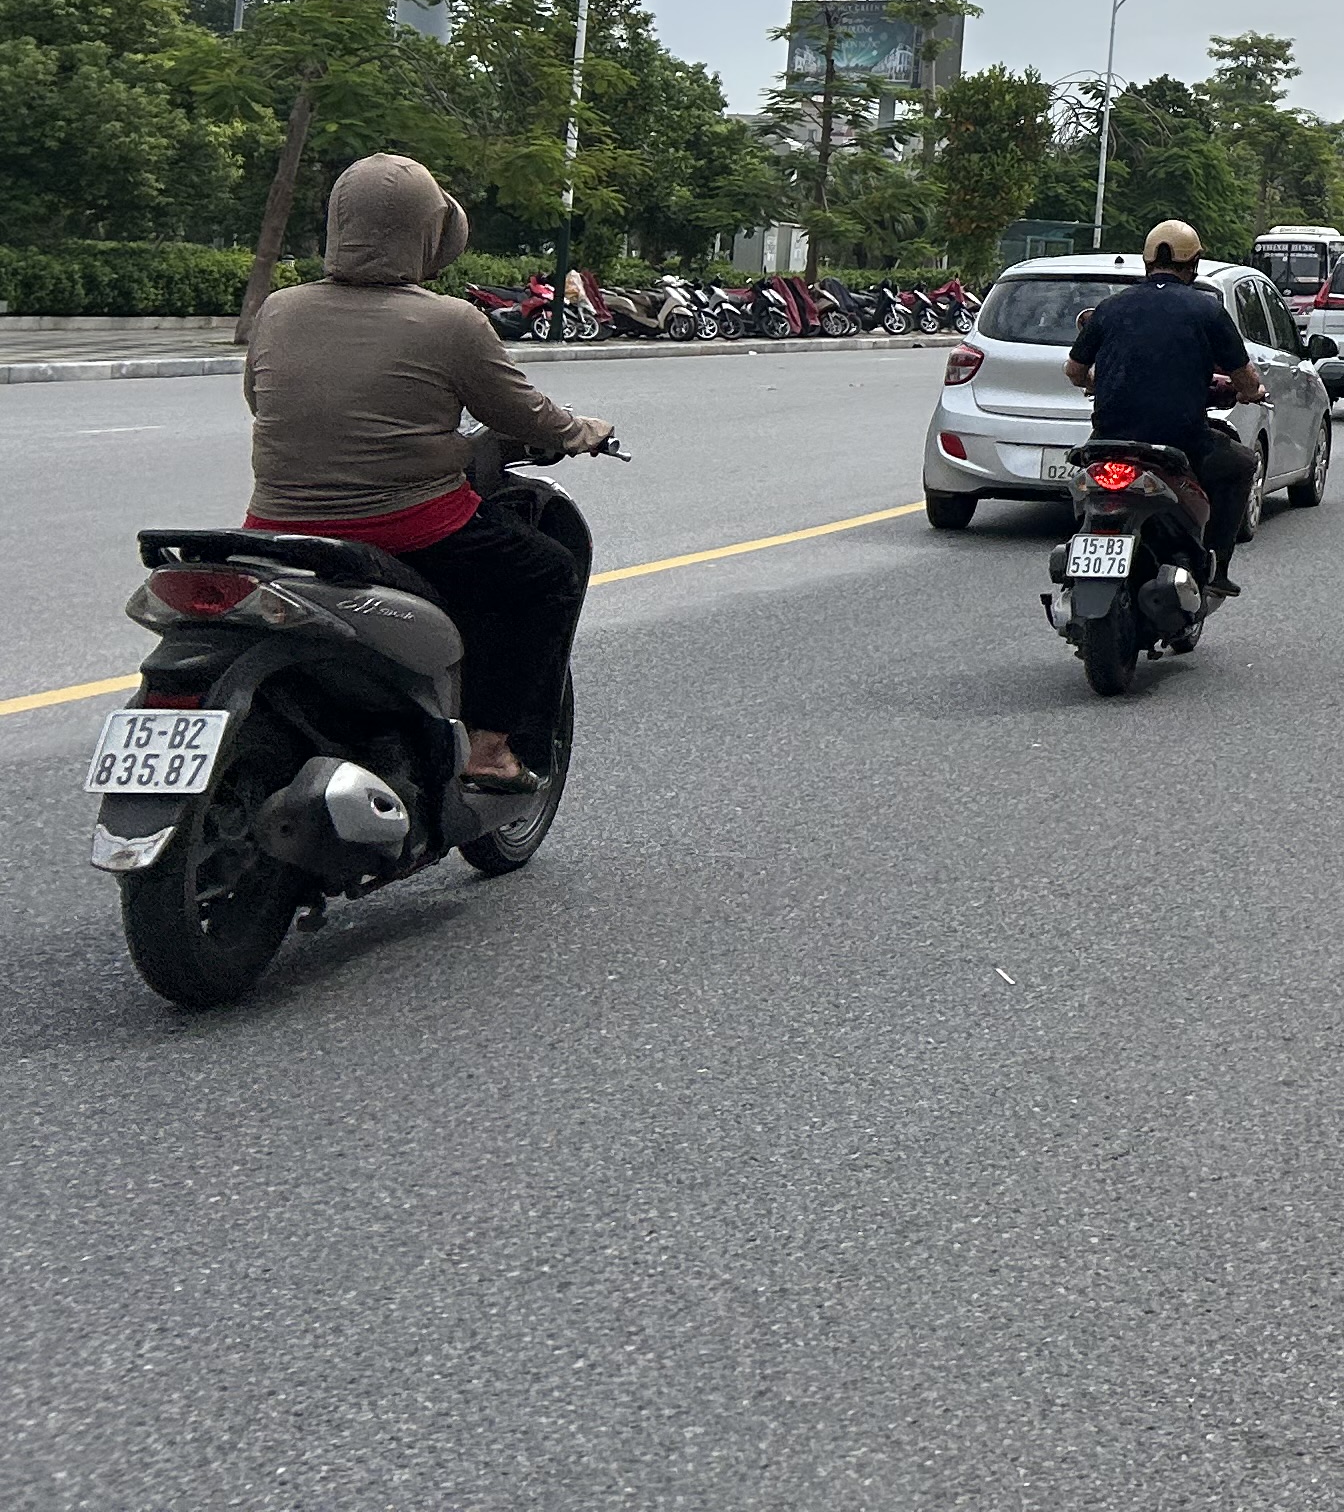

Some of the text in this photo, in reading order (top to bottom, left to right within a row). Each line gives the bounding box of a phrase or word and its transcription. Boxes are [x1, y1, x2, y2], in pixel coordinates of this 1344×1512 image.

[1082, 538, 1124, 555] 15-B3
[1071, 557, 1126, 575] 530.76
[123, 716, 208, 749] 15-B2
[95, 753, 208, 787] 835.87
